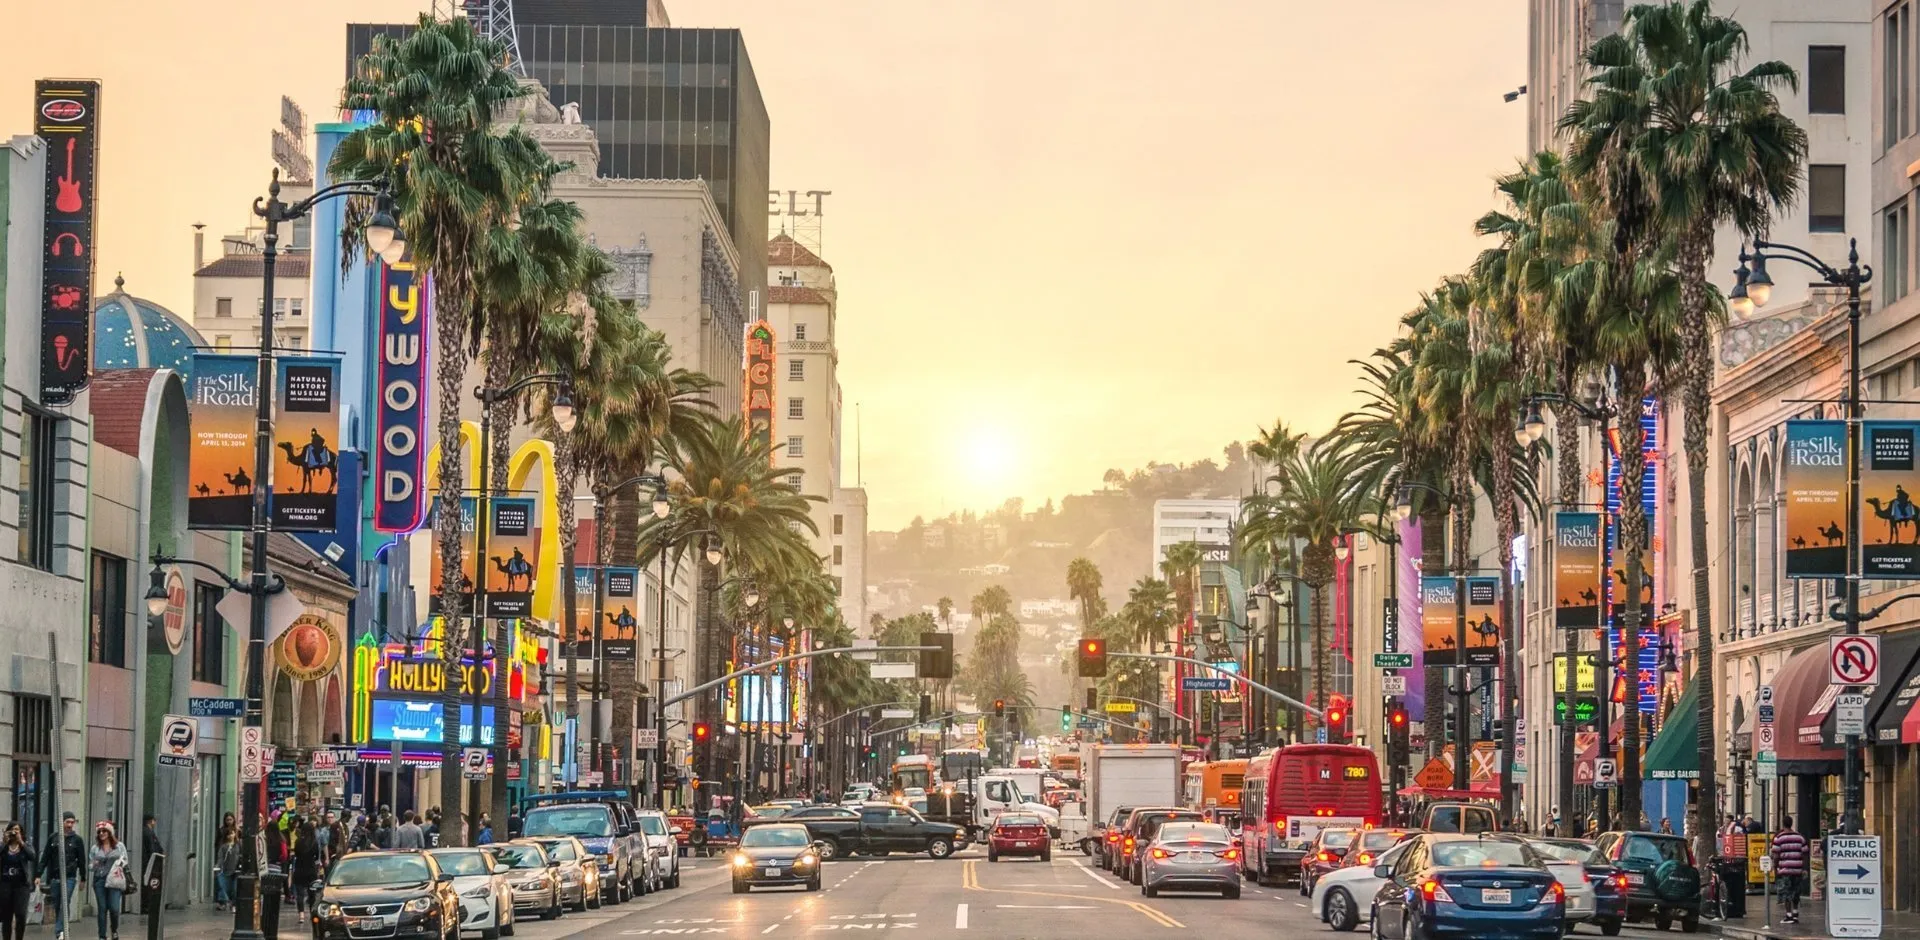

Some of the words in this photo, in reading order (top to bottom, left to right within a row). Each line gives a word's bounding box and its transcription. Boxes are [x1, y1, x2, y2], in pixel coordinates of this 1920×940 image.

[204, 376, 217, 385] The
[218, 374, 250, 392] Silk
[384, 262, 419, 502] YWOOD
[203, 386, 253, 406] Road
[1809, 436, 1838, 453] Silk
[1796, 448, 1842, 466] Road
[1572, 525, 1593, 538] Silk
[1563, 533, 1597, 547] Road
[576, 583, 592, 594] oad
[1435, 586, 1452, 596] Silk
[1428, 593, 1455, 604] Road
[315, 617, 337, 641] KING
[283, 663, 306, 679] Since
[309, 666, 328, 679] 1989
[1186, 681, 1215, 689] Highland
[191, 698, 234, 709] McCadden
[1837, 696, 1863, 705] LAPD
[160, 756, 173, 764] PAY
[175, 759, 192, 767] HERE
[313, 752, 335, 764] ATM
[1320, 769, 1330, 779] M
[1347, 766, 1365, 778] 780
[431, 836, 438, 846] 5
[1831, 840, 1877, 849] PUBLIC
[1830, 850, 1878, 859] PARKING
[1834, 887, 1846, 895] PARK
[1848, 887, 1860, 895] LOCK
[1862, 887, 1875, 895] WALK
